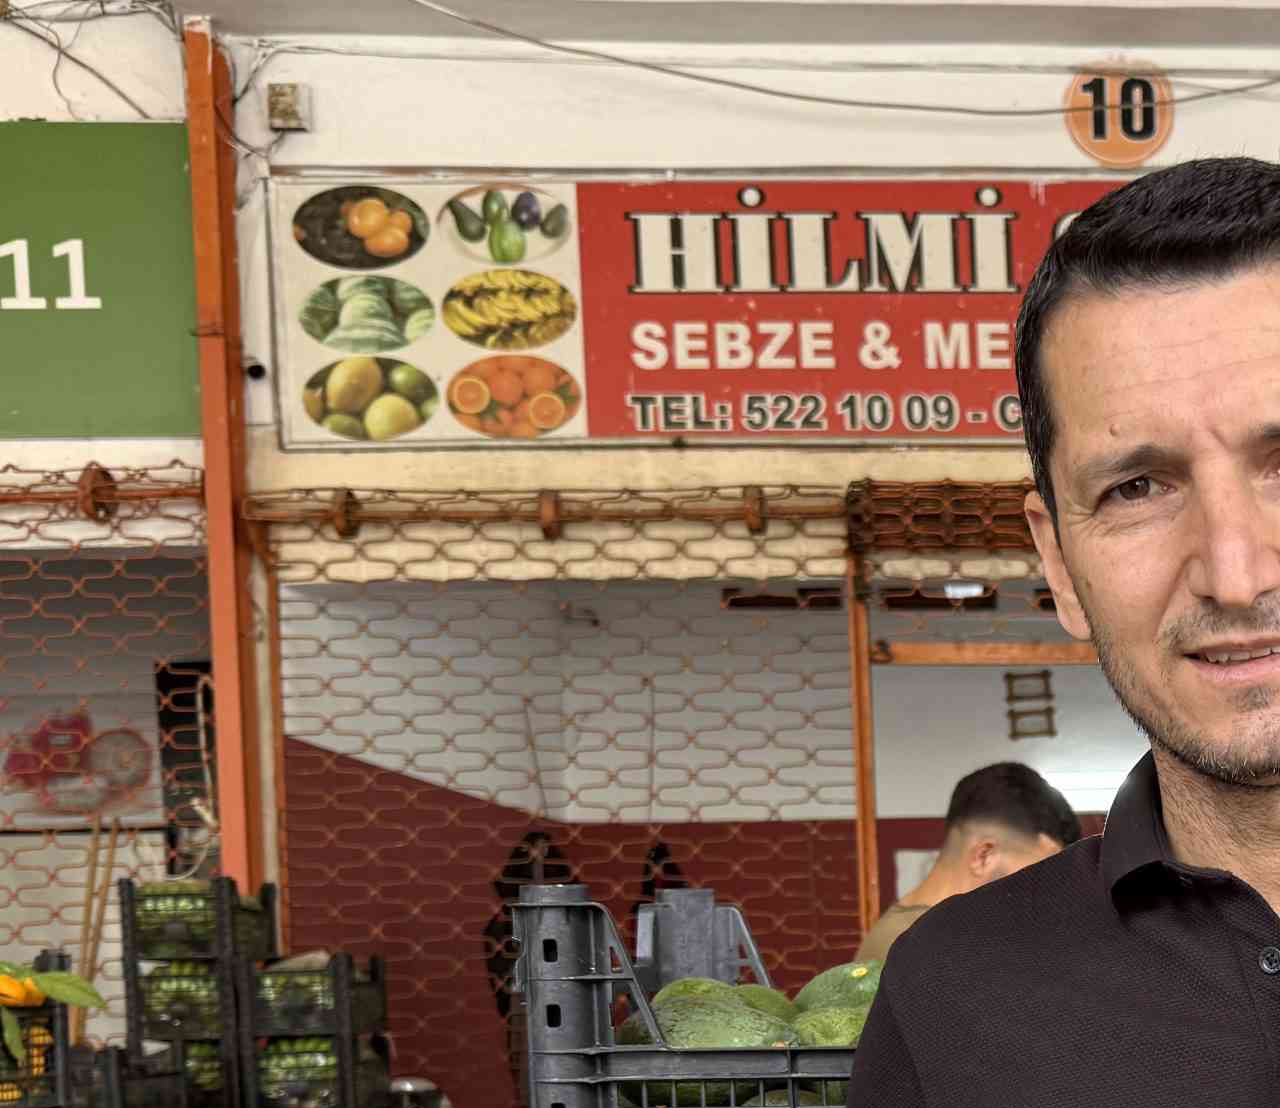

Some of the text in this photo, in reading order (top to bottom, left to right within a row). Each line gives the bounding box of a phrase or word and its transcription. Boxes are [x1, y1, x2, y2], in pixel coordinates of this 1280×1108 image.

[1082, 78, 1154, 140] 10
[624, 185, 1020, 294] HİLMİ
[0, 239, 102, 309] 11
[631, 321, 836, 370] SEBZE
[858, 321, 902, 370] &
[923, 322, 1019, 370] ME
[626, 394, 733, 431] TEL:
[743, 394, 827, 431] 522
[837, 393, 893, 432] 10
[901, 393, 960, 432] 09
